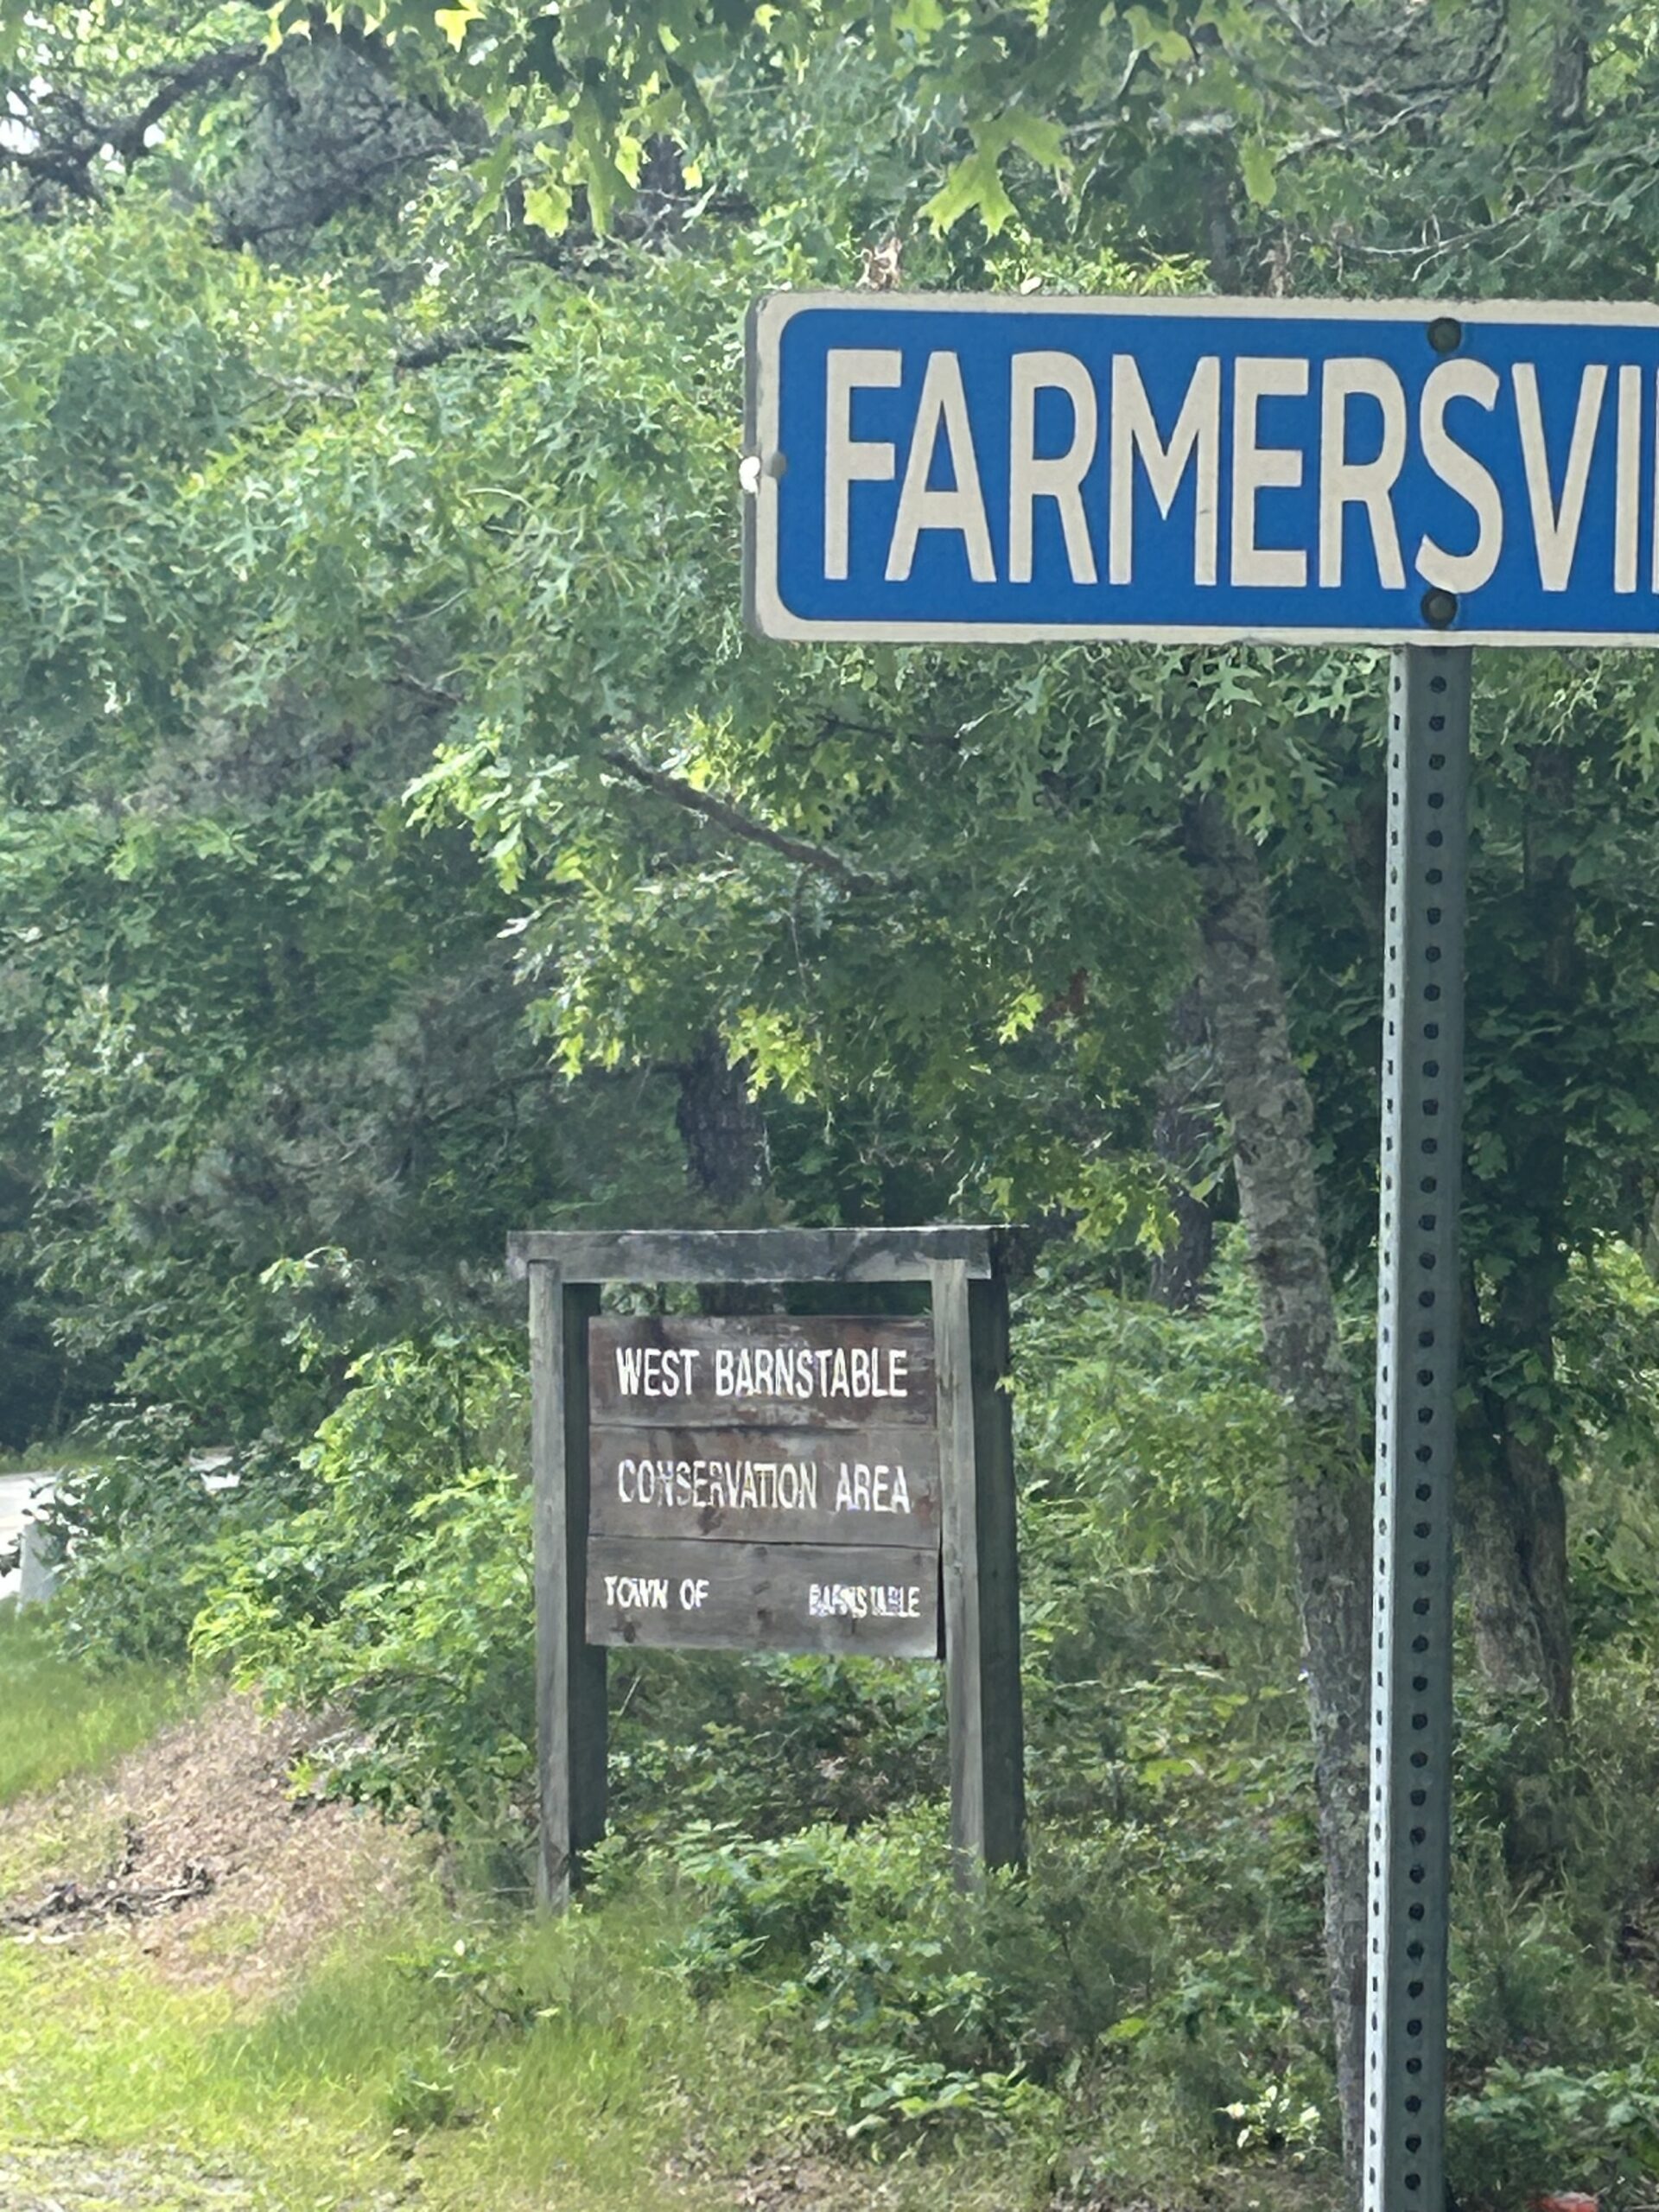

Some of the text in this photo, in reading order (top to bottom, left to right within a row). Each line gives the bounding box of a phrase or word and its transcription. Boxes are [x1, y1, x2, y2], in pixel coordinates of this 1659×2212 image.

[824, 349, 1659, 594] FARMERSVI
[616, 1347, 908, 1398] WEST BARNSTABLE
[617, 1459, 911, 1514] CONSERVATION AREA
[604, 1575, 669, 1609] TOWN
[679, 1579, 709, 1610] OF
